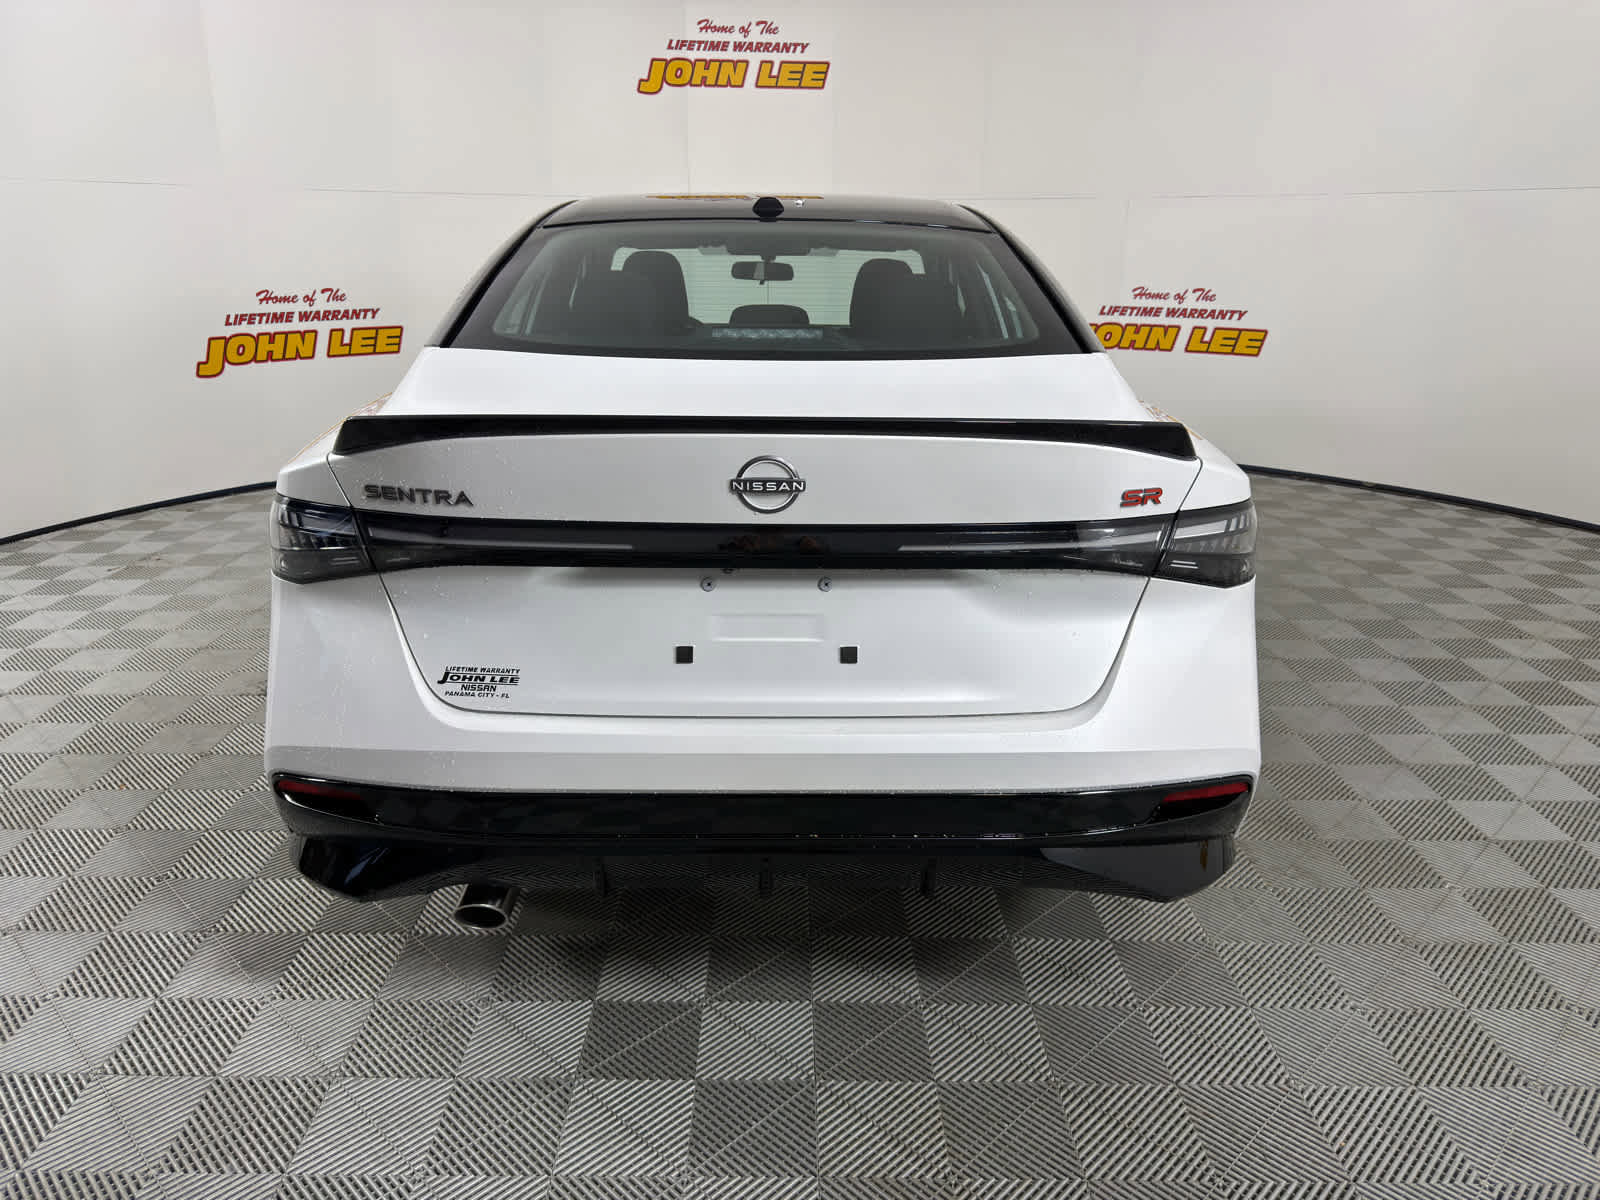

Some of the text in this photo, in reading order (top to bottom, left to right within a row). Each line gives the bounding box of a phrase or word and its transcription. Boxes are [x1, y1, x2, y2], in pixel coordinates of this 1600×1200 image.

[697, 19, 780, 38] Home of The
[666, 39, 810, 54] LIFETIME WARRANTY
[637, 57, 830, 95] JOHN LEE
[255, 287, 347, 307] Home of The
[1131, 286, 1216, 304] Home of The
[224, 308, 380, 326] LIFETIME WARRANTY
[1098, 305, 1248, 321] LIFETIME WARRANTY
[1089, 322, 1268, 357] OHN LEE
[196, 325, 403, 378] JOHN LEE
[731, 480, 805, 492] NISSAN
[364, 484, 474, 507] SENTRA
[1120, 487, 1163, 507] SR
[437, 671, 520, 684] JOHN LEE
[460, 684, 497, 692] NISSAN
